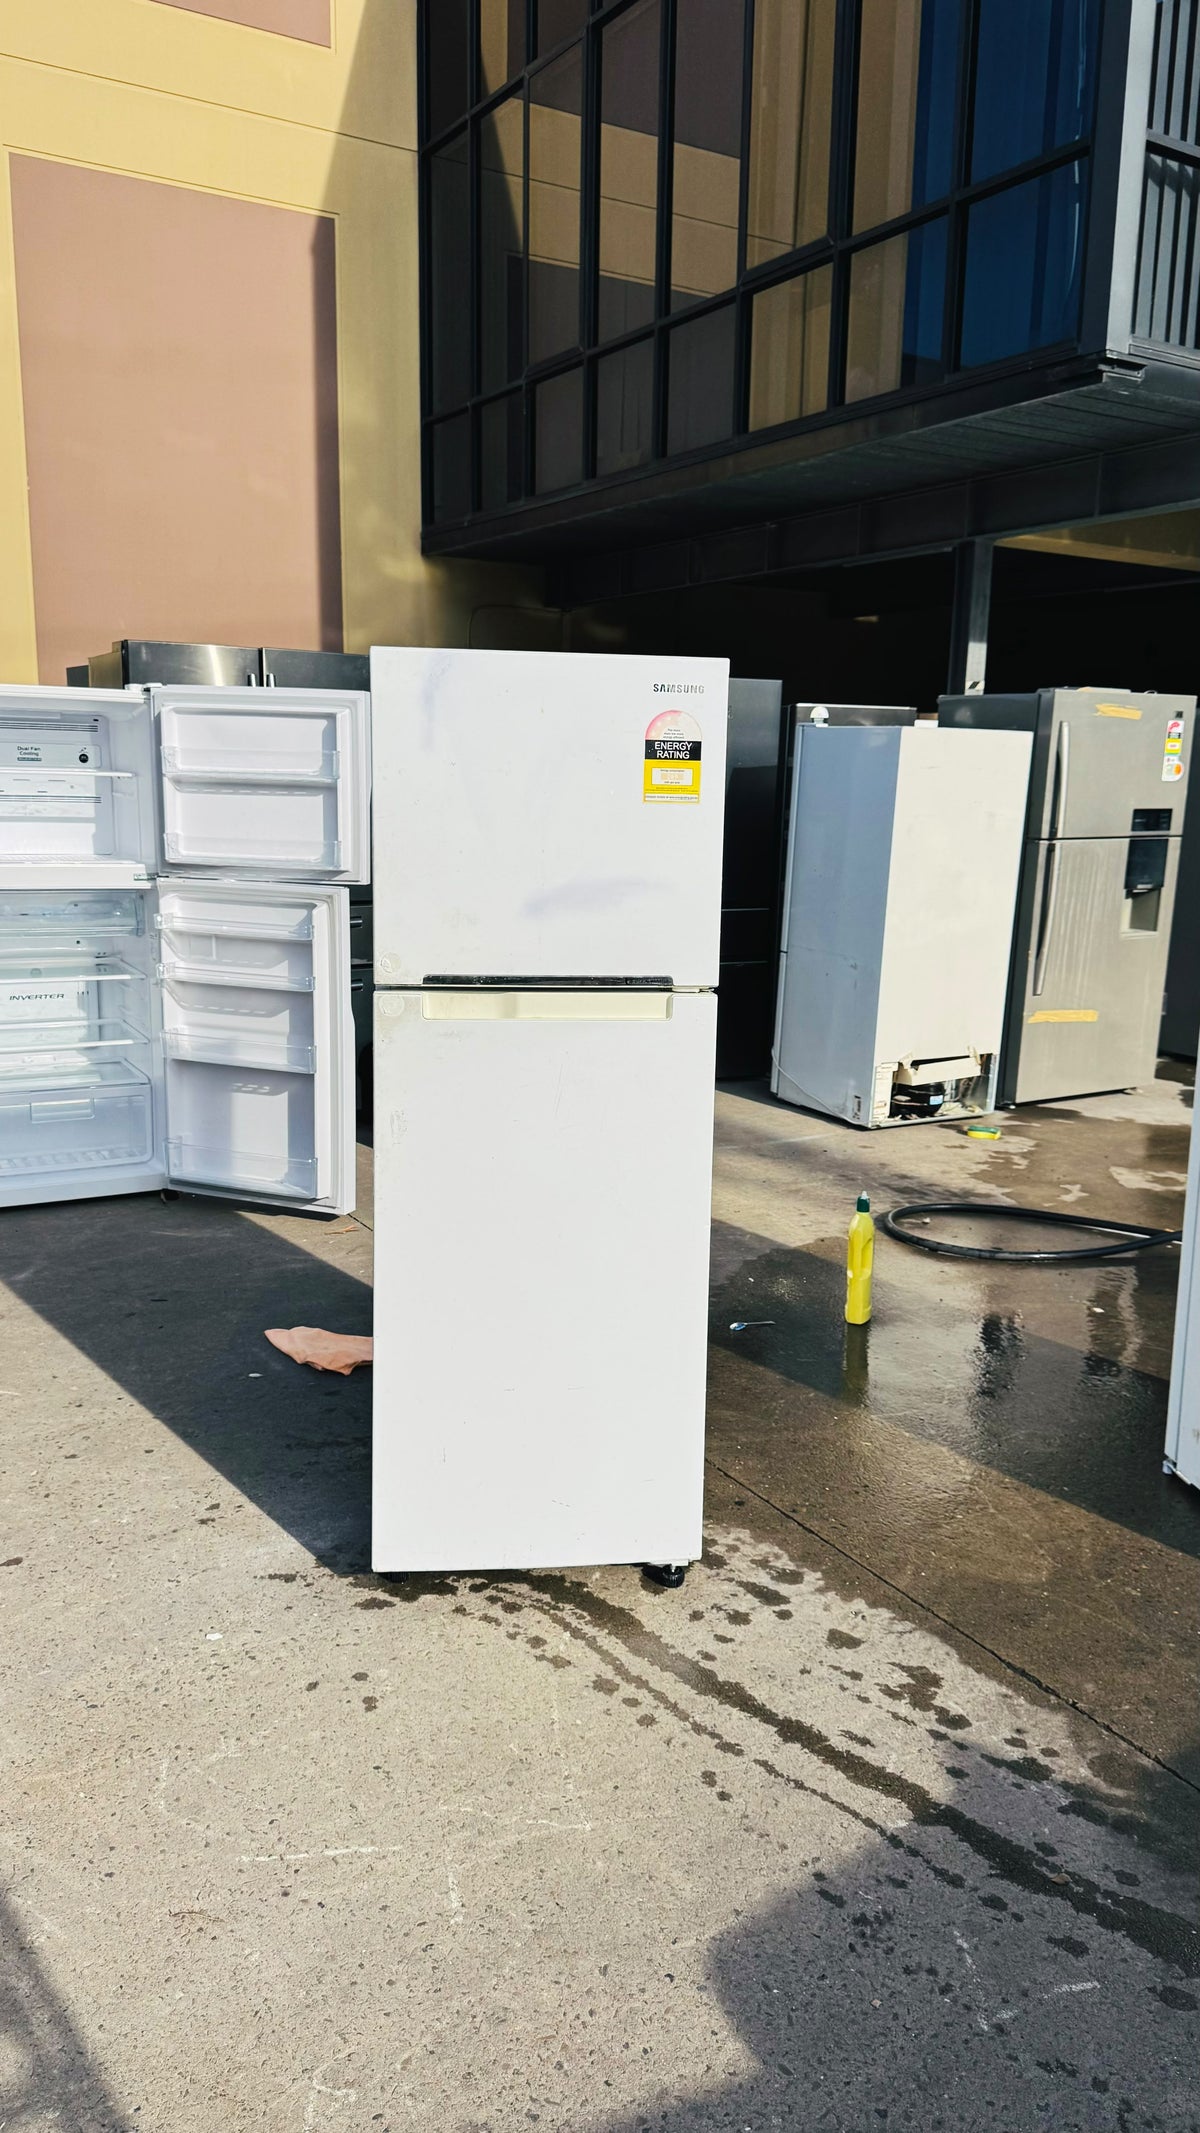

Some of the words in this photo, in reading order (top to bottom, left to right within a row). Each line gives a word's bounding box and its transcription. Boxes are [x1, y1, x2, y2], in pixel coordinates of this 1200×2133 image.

[653, 683, 705, 694] SAMSUNG
[654, 741, 693, 751] ENERGY
[656, 750, 690, 760] RATING
[9, 993, 65, 1001] INVERTER
